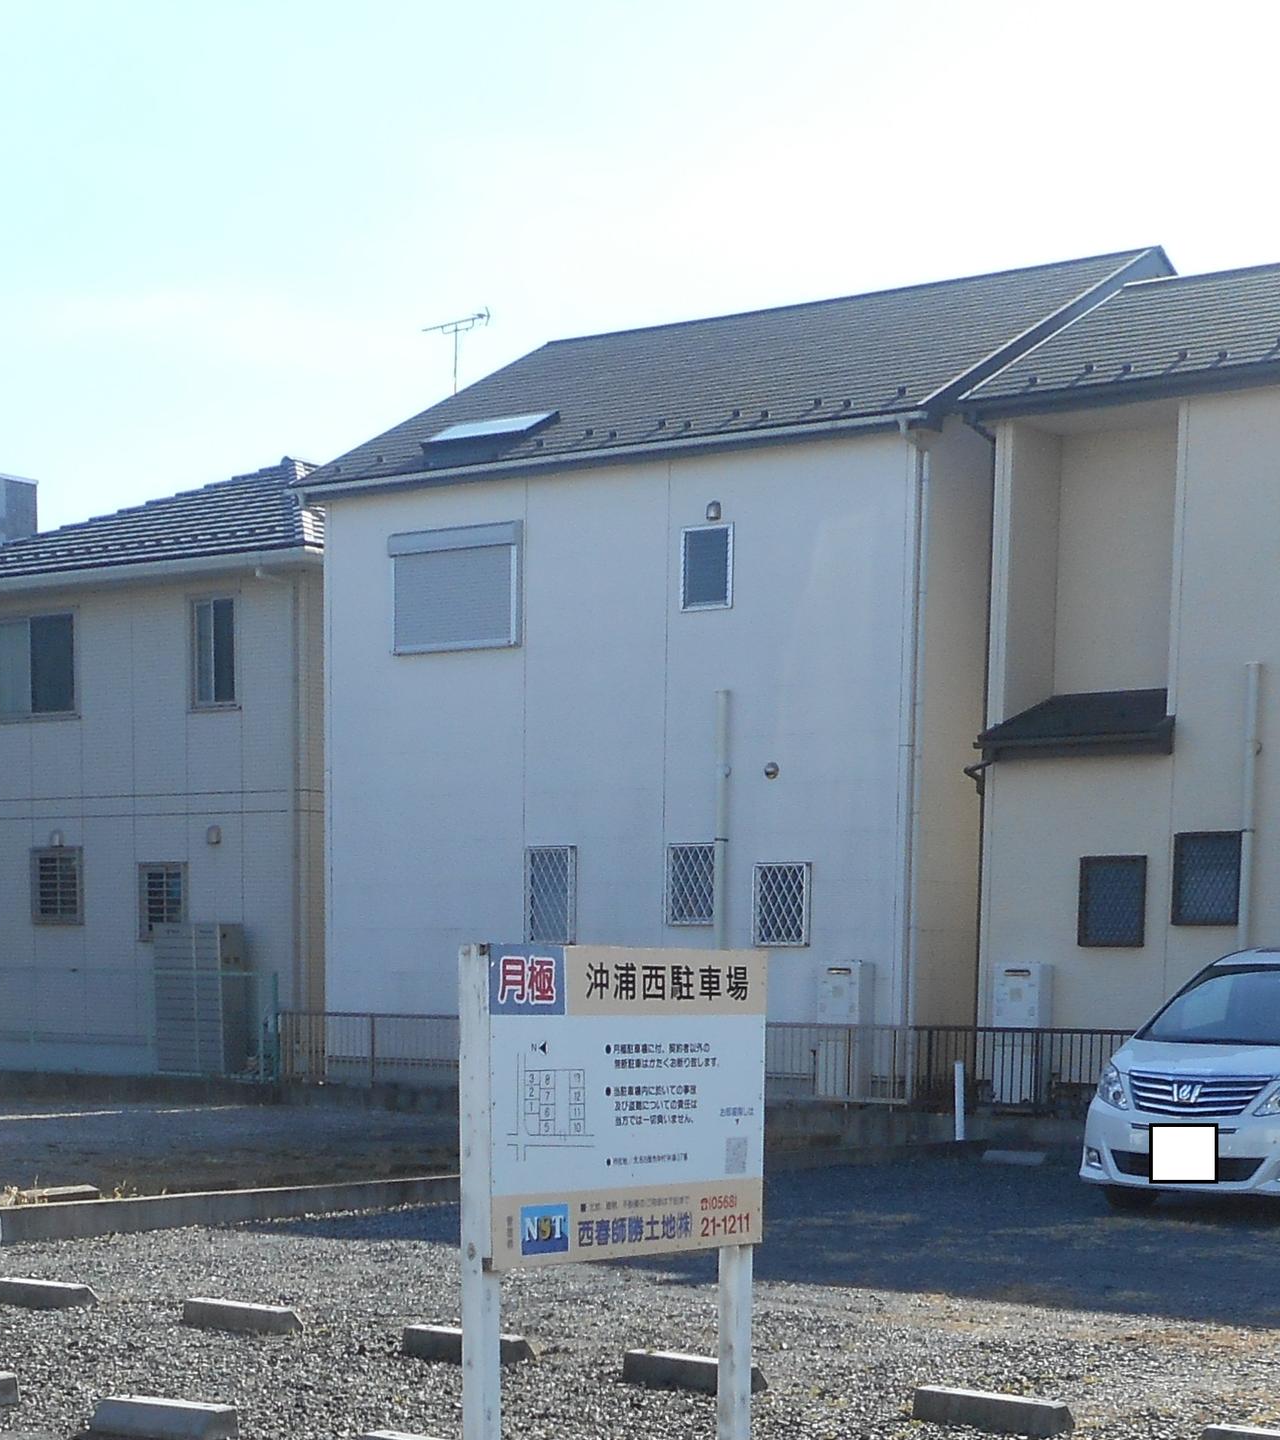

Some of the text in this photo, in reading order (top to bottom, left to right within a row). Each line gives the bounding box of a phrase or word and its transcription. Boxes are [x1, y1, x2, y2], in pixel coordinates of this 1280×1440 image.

[498, 956, 556, 1004] 月極
[585, 962, 749, 1001] 沖浦西駐車場
[531, 1043, 537, 1052] N
[544, 1074, 551, 1086] 8
[528, 1087, 535, 1098] 2
[544, 1091, 551, 1101] 7
[543, 1122, 551, 1133] 5
[701, 1212, 750, 1237] 21-1211
